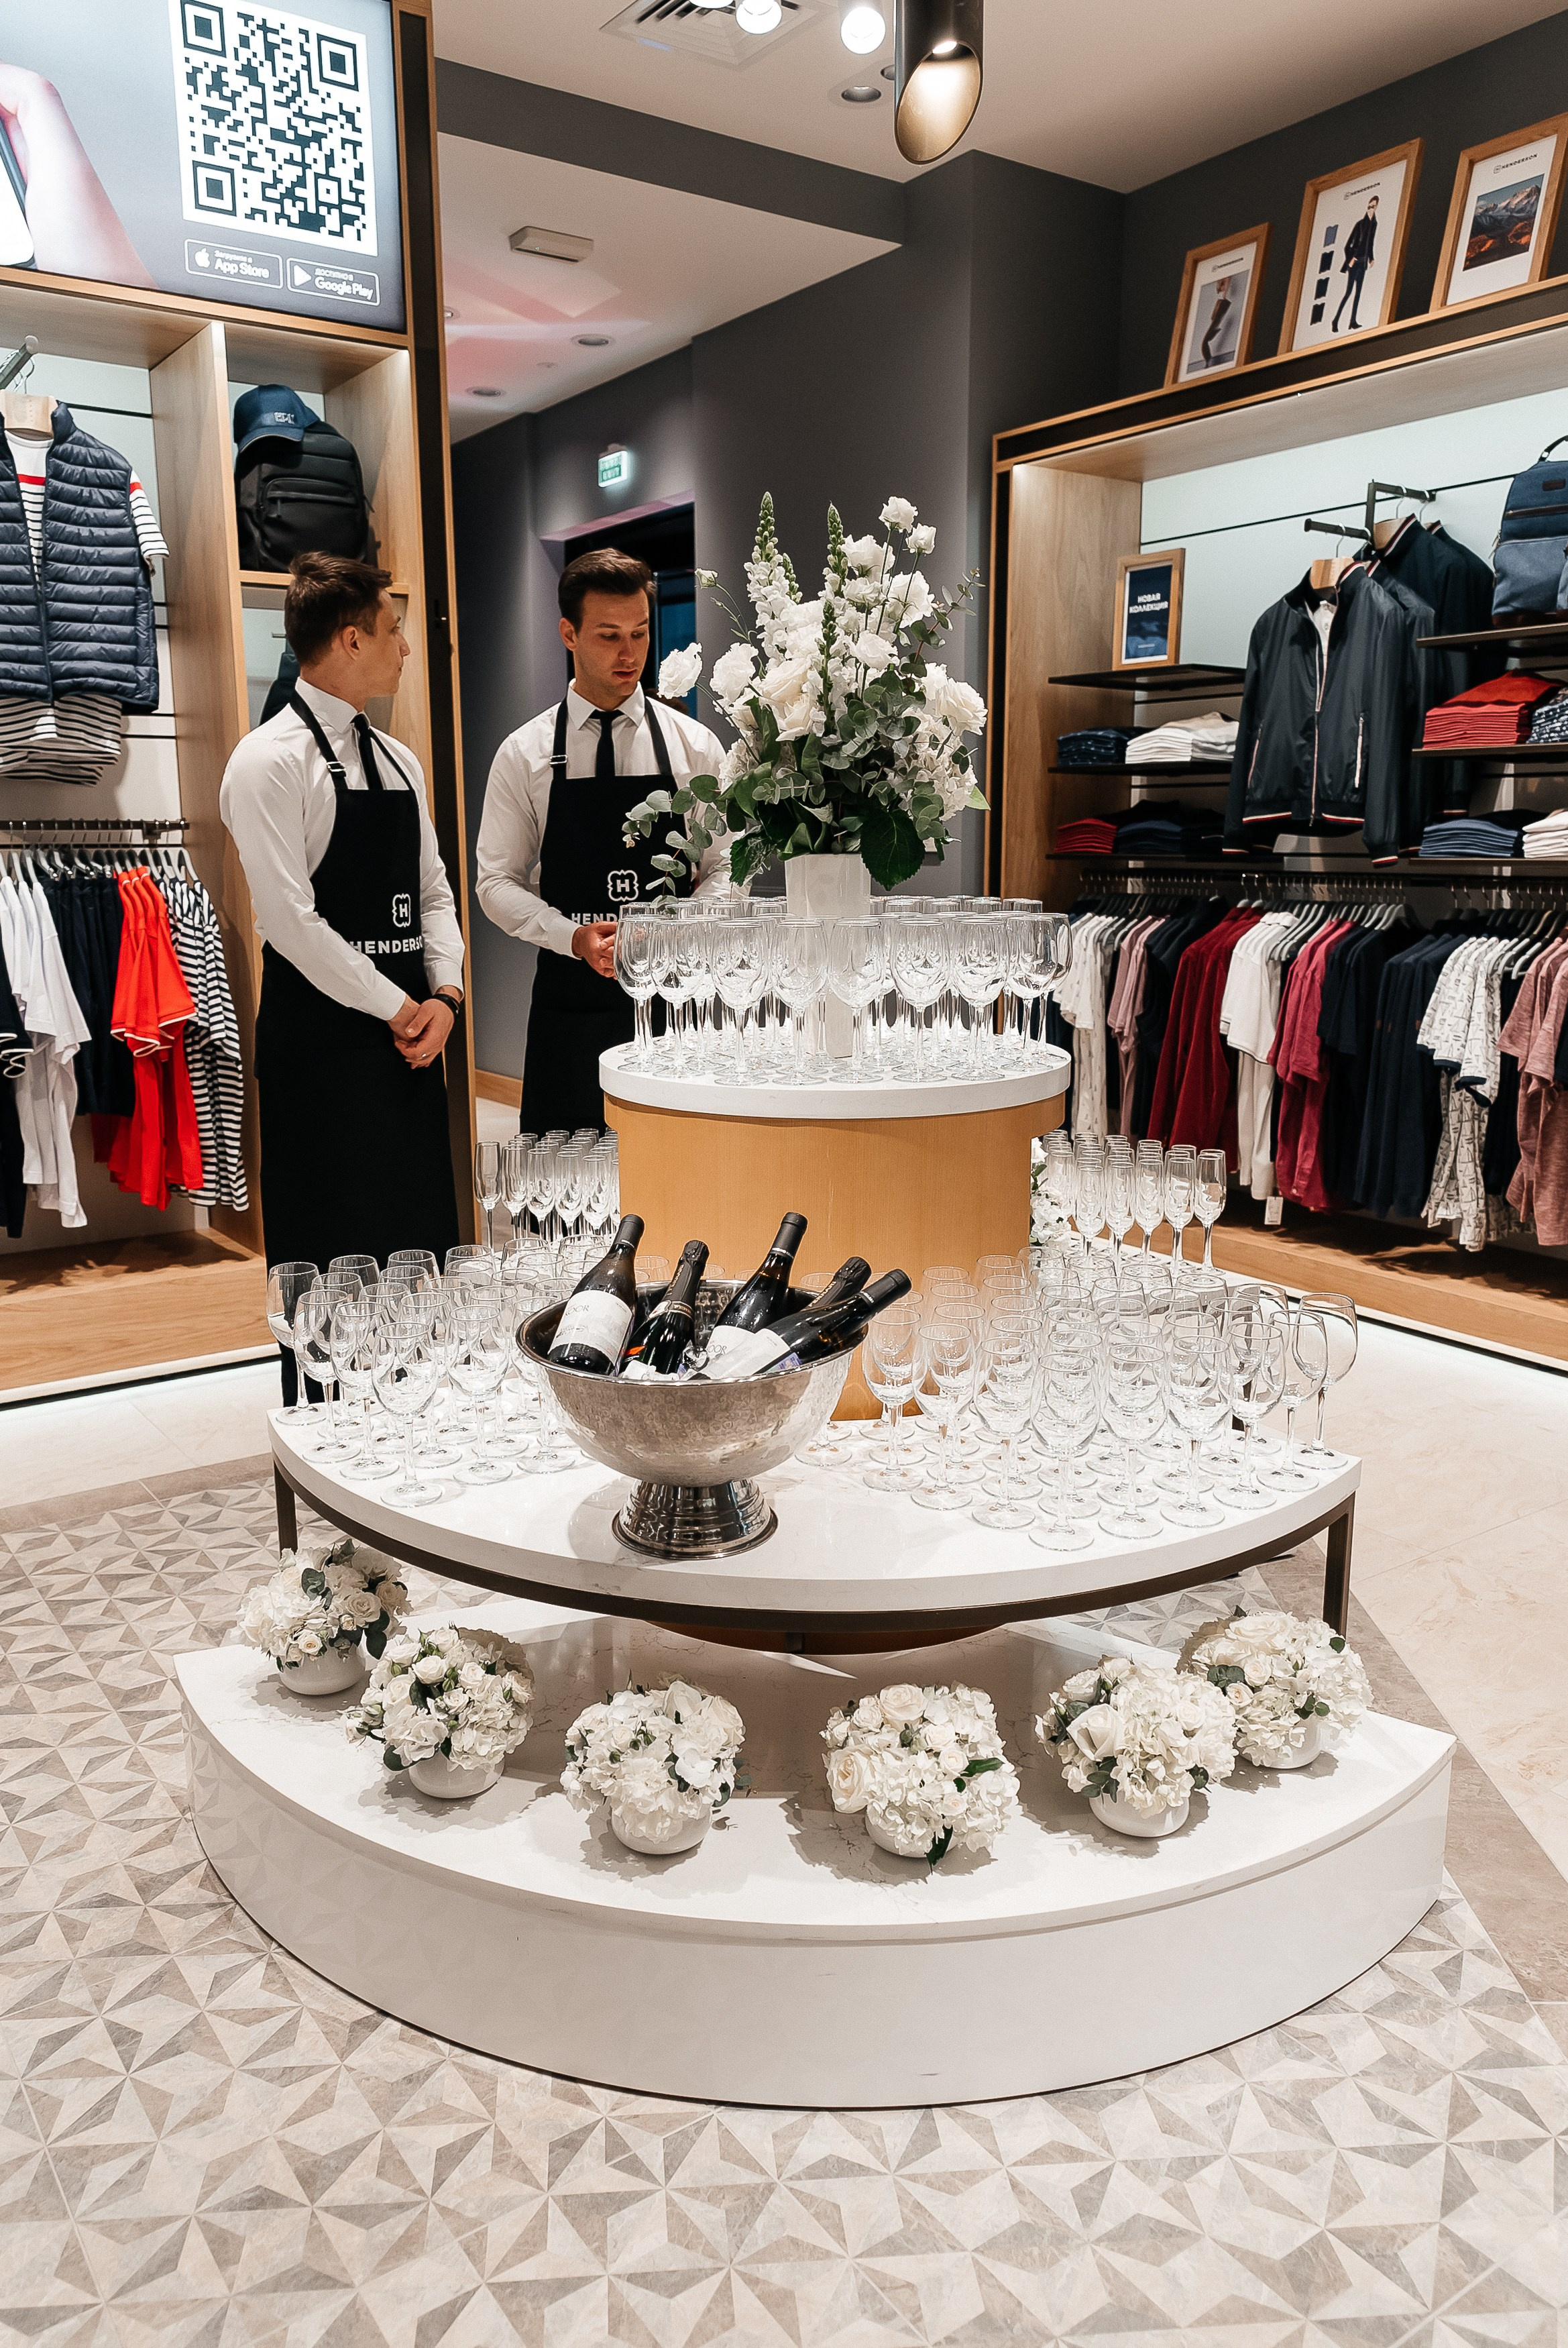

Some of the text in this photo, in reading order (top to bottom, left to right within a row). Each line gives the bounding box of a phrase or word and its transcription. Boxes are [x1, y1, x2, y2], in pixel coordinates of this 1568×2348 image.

[214, 258, 270, 278] App Store
[315, 276, 374, 301] Google Play
[616, 879, 630, 892] H
[399, 903, 408, 918] H
[565, 1305, 590, 1316] OOR
[707, 1344, 727, 1355] OOR
